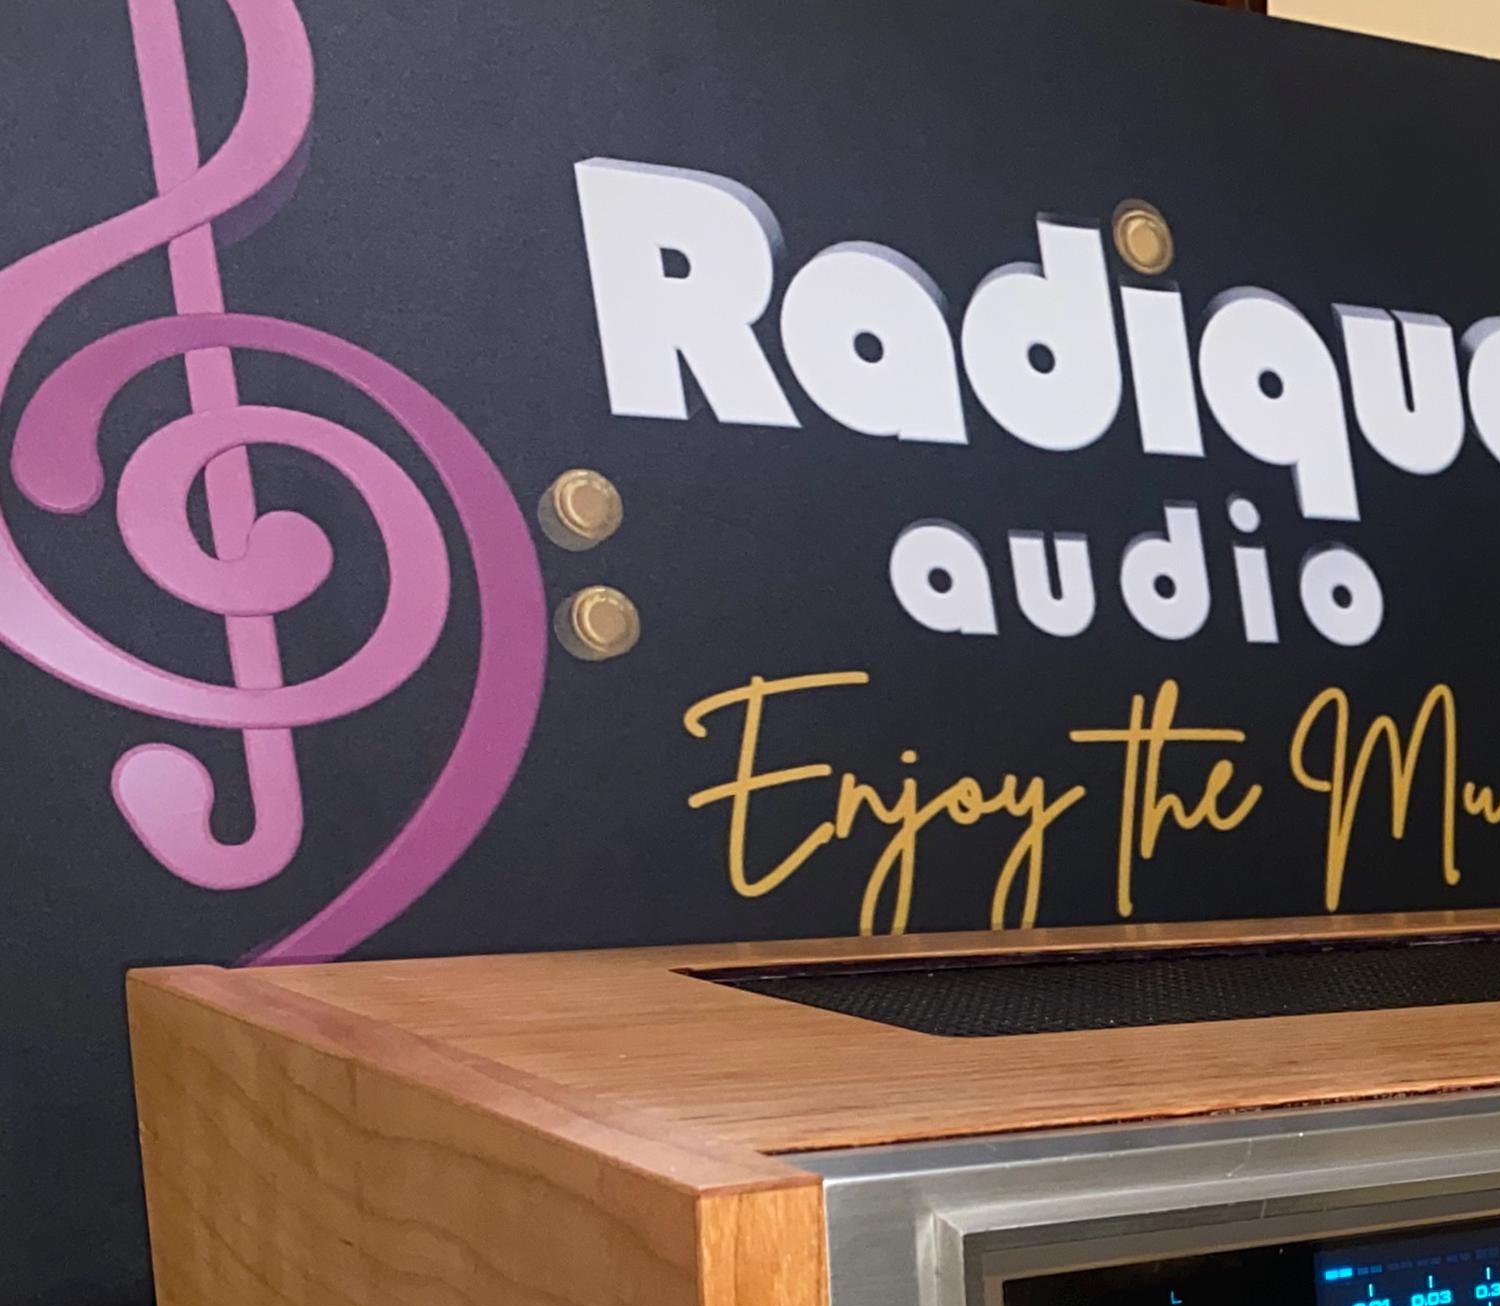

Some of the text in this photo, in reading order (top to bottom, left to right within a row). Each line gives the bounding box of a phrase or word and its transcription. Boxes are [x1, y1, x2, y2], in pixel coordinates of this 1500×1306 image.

[889, 491, 1384, 645] audio
[683, 670, 1086, 931] Enjoy
[1070, 679, 1261, 917] the
[1170, 1291, 1182, 1304] L
